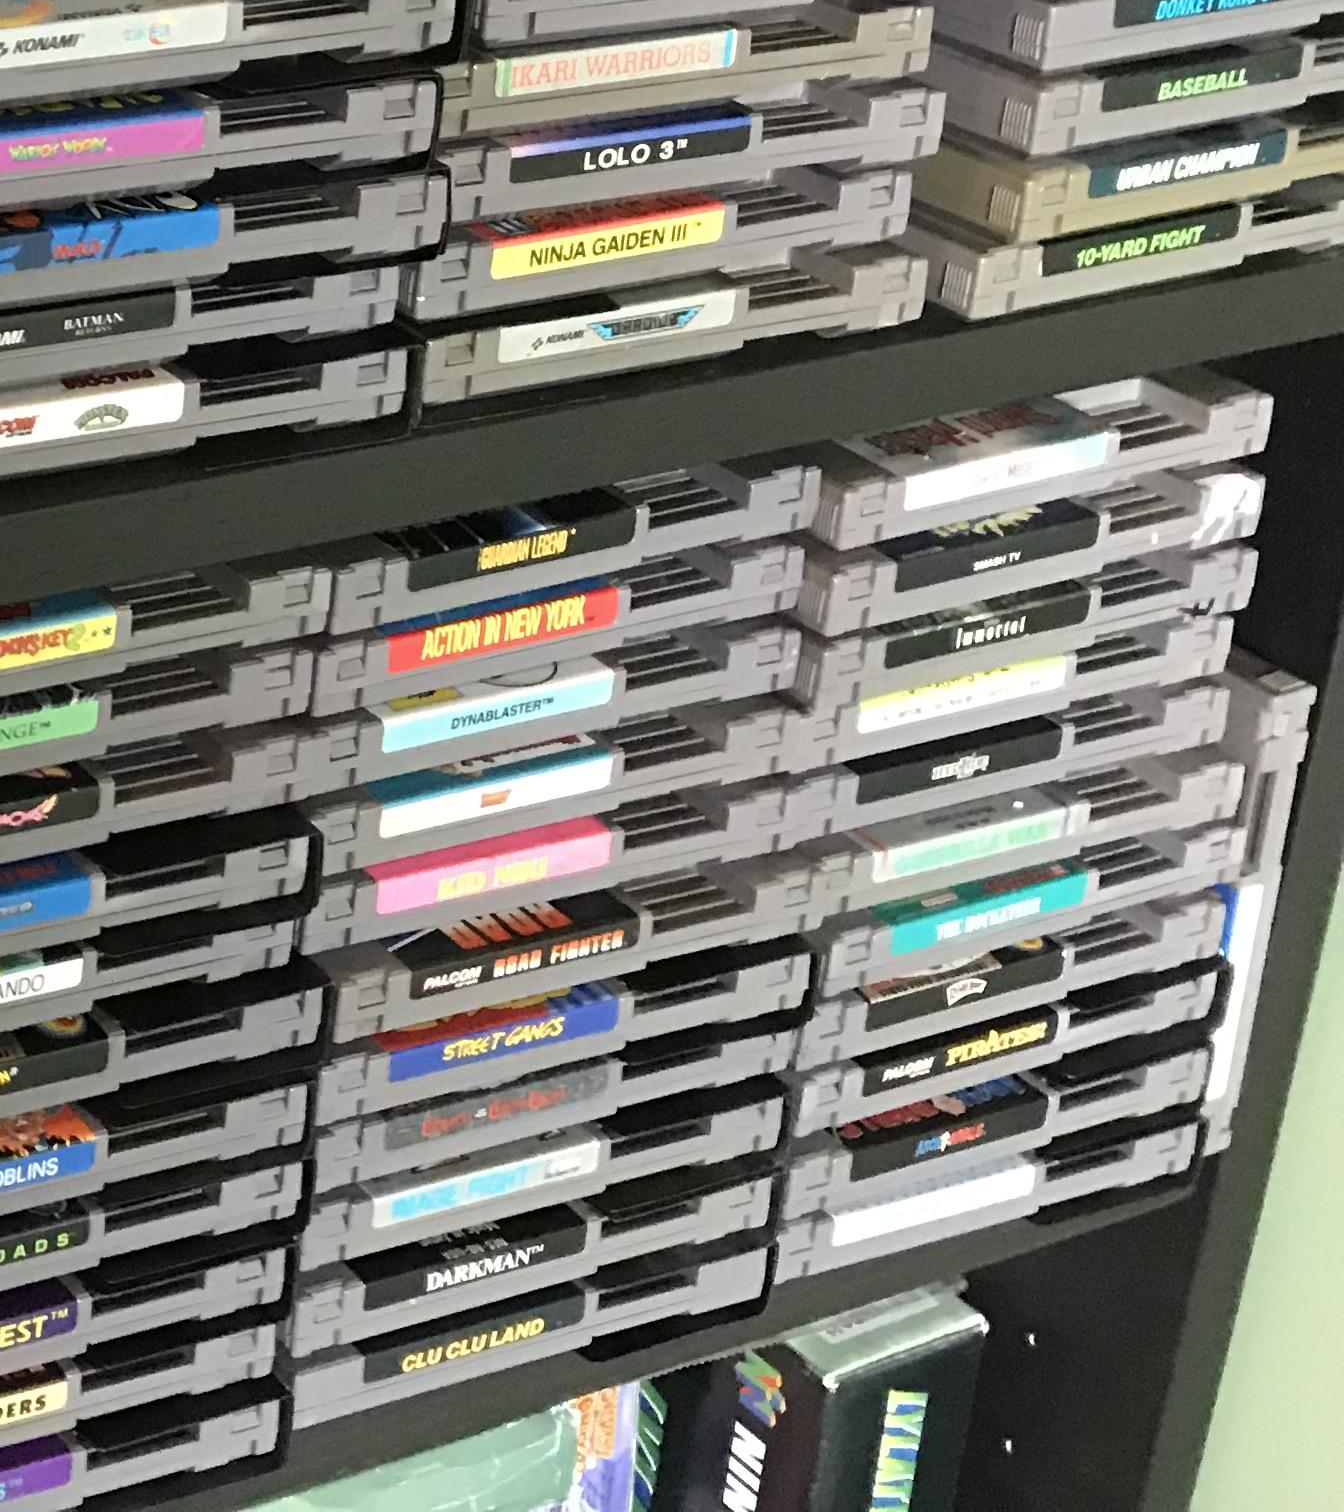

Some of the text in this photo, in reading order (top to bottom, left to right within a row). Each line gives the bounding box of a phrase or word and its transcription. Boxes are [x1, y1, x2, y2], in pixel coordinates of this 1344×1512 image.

[12, 34, 82, 55] KONAMI
[511, 40, 712, 89] IKARI WARRIORS
[1157, 68, 1249, 102] BASEBALL
[583, 143, 650, 171] LOLO
[1116, 142, 1261, 191] URBAN CHAMPION
[529, 224, 688, 268] NINJA GAIDEN III
[1076, 225, 1206, 268] 10-YARD FIGHT
[63, 312, 125, 331] BATMAN
[421, 595, 587, 661] ACTION IN NEW YORK
[451, 698, 542, 730] DYNABLASTER
[442, 1016, 566, 1062] STREET GANGS
[425, 1250, 531, 1292] DARKMAN
[401, 1316, 546, 1374] CLU CLU LAND
